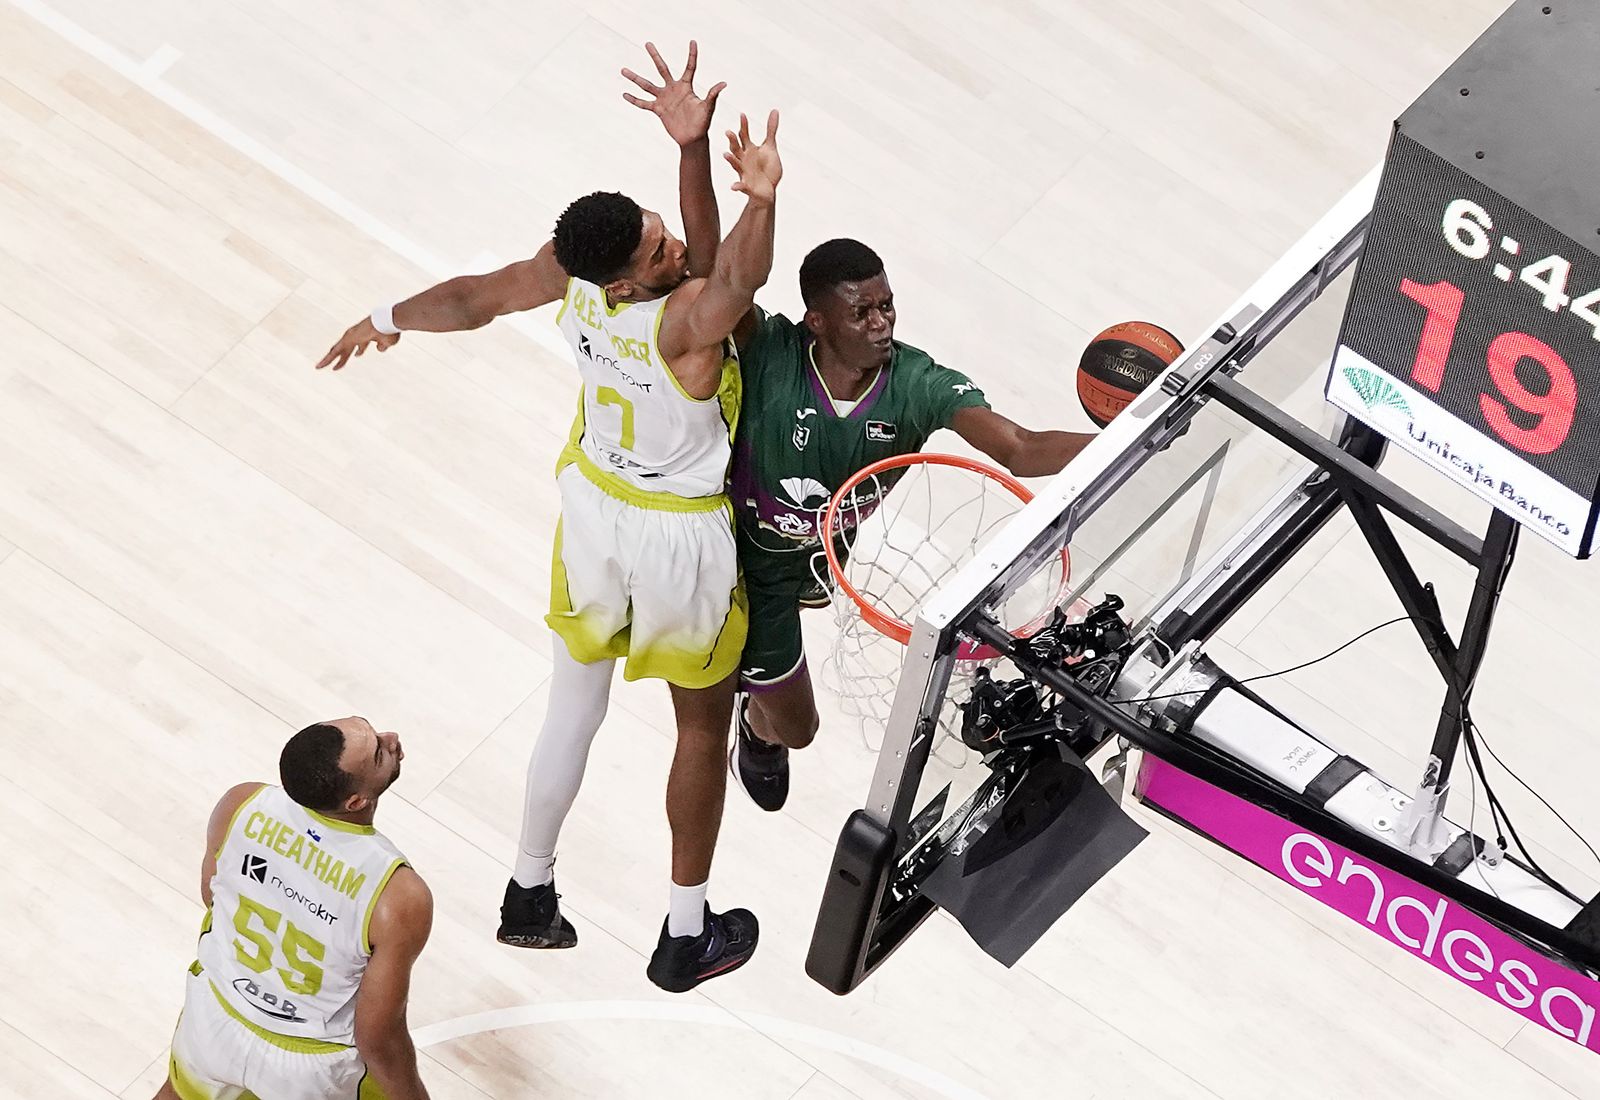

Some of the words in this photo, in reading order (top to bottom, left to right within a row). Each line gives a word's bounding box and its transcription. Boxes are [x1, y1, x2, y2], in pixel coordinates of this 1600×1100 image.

[596, 385, 635, 452] 7
[1399, 276, 1579, 456] 19
[1405, 419, 1495, 491] Unicaja
[1499, 478, 1573, 538] Banco
[243, 810, 367, 901] CHEATHAM
[232, 892, 326, 997] 55
[1280, 832, 1597, 1047] endesa
